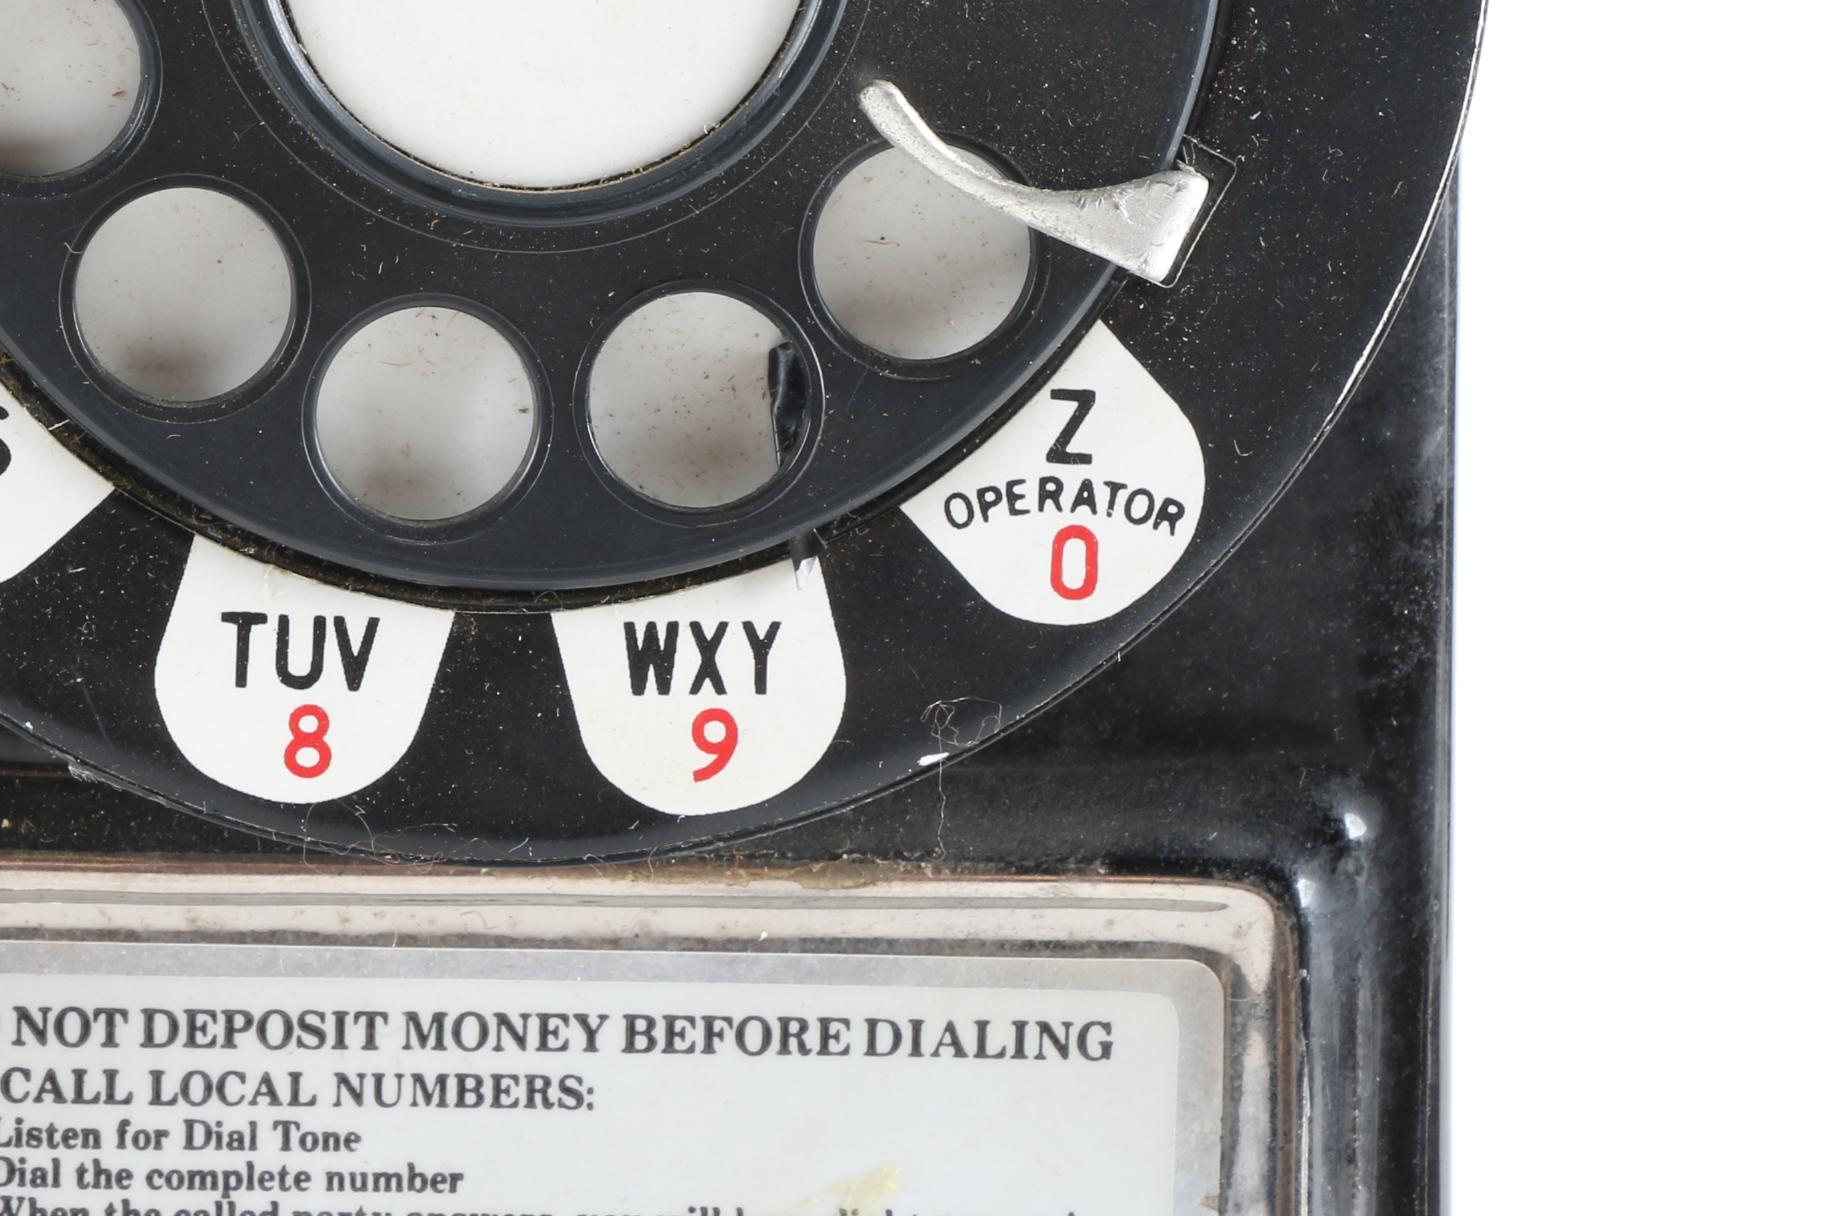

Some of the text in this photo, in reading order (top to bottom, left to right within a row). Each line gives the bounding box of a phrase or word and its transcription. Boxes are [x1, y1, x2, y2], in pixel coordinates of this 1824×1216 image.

[1045, 388, 1096, 465] Z
[944, 475, 1185, 536] OPERATOR
[1051, 525, 1098, 600] 0
[221, 611, 381, 692] TUV
[623, 620, 782, 696] WXY
[285, 704, 332, 778] 8
[692, 708, 738, 782] 9
[12, 1006, 128, 1048] NOT
[140, 1008, 388, 1050] DEPOSIT
[402, 1012, 609, 1052] MONEY
[622, 1014, 850, 1056] BEFORE
[864, 1018, 1113, 1061] DIALING
[0, 1067, 133, 1105] CALL
[149, 1070, 316, 1106] LOCAL
[333, 1073, 593, 1110] NUMBERS:
[116, 1119, 169, 1150] for
[183, 1119, 259, 1152] Dial
[273, 1120, 362, 1153] Tone
[76, 1158, 133, 1190] the
[146, 1161, 311, 1199] complete
[326, 1162, 463, 1193] number
